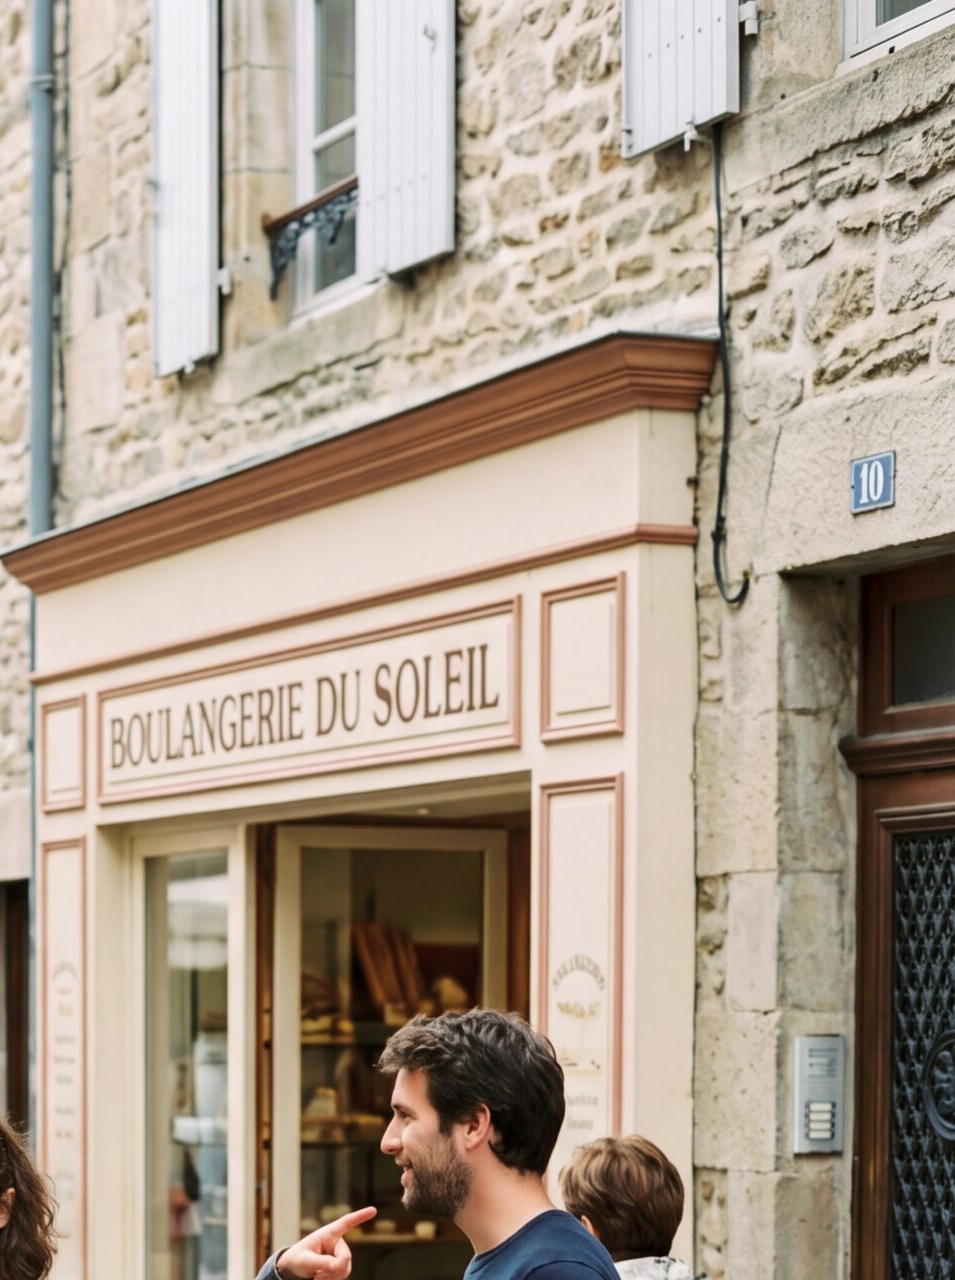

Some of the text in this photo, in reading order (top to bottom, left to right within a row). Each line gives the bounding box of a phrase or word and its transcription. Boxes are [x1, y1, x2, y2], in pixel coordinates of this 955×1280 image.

[859, 460, 884, 504] 10
[110, 643, 500, 769] BOULANGERIE DU SOLEIL
